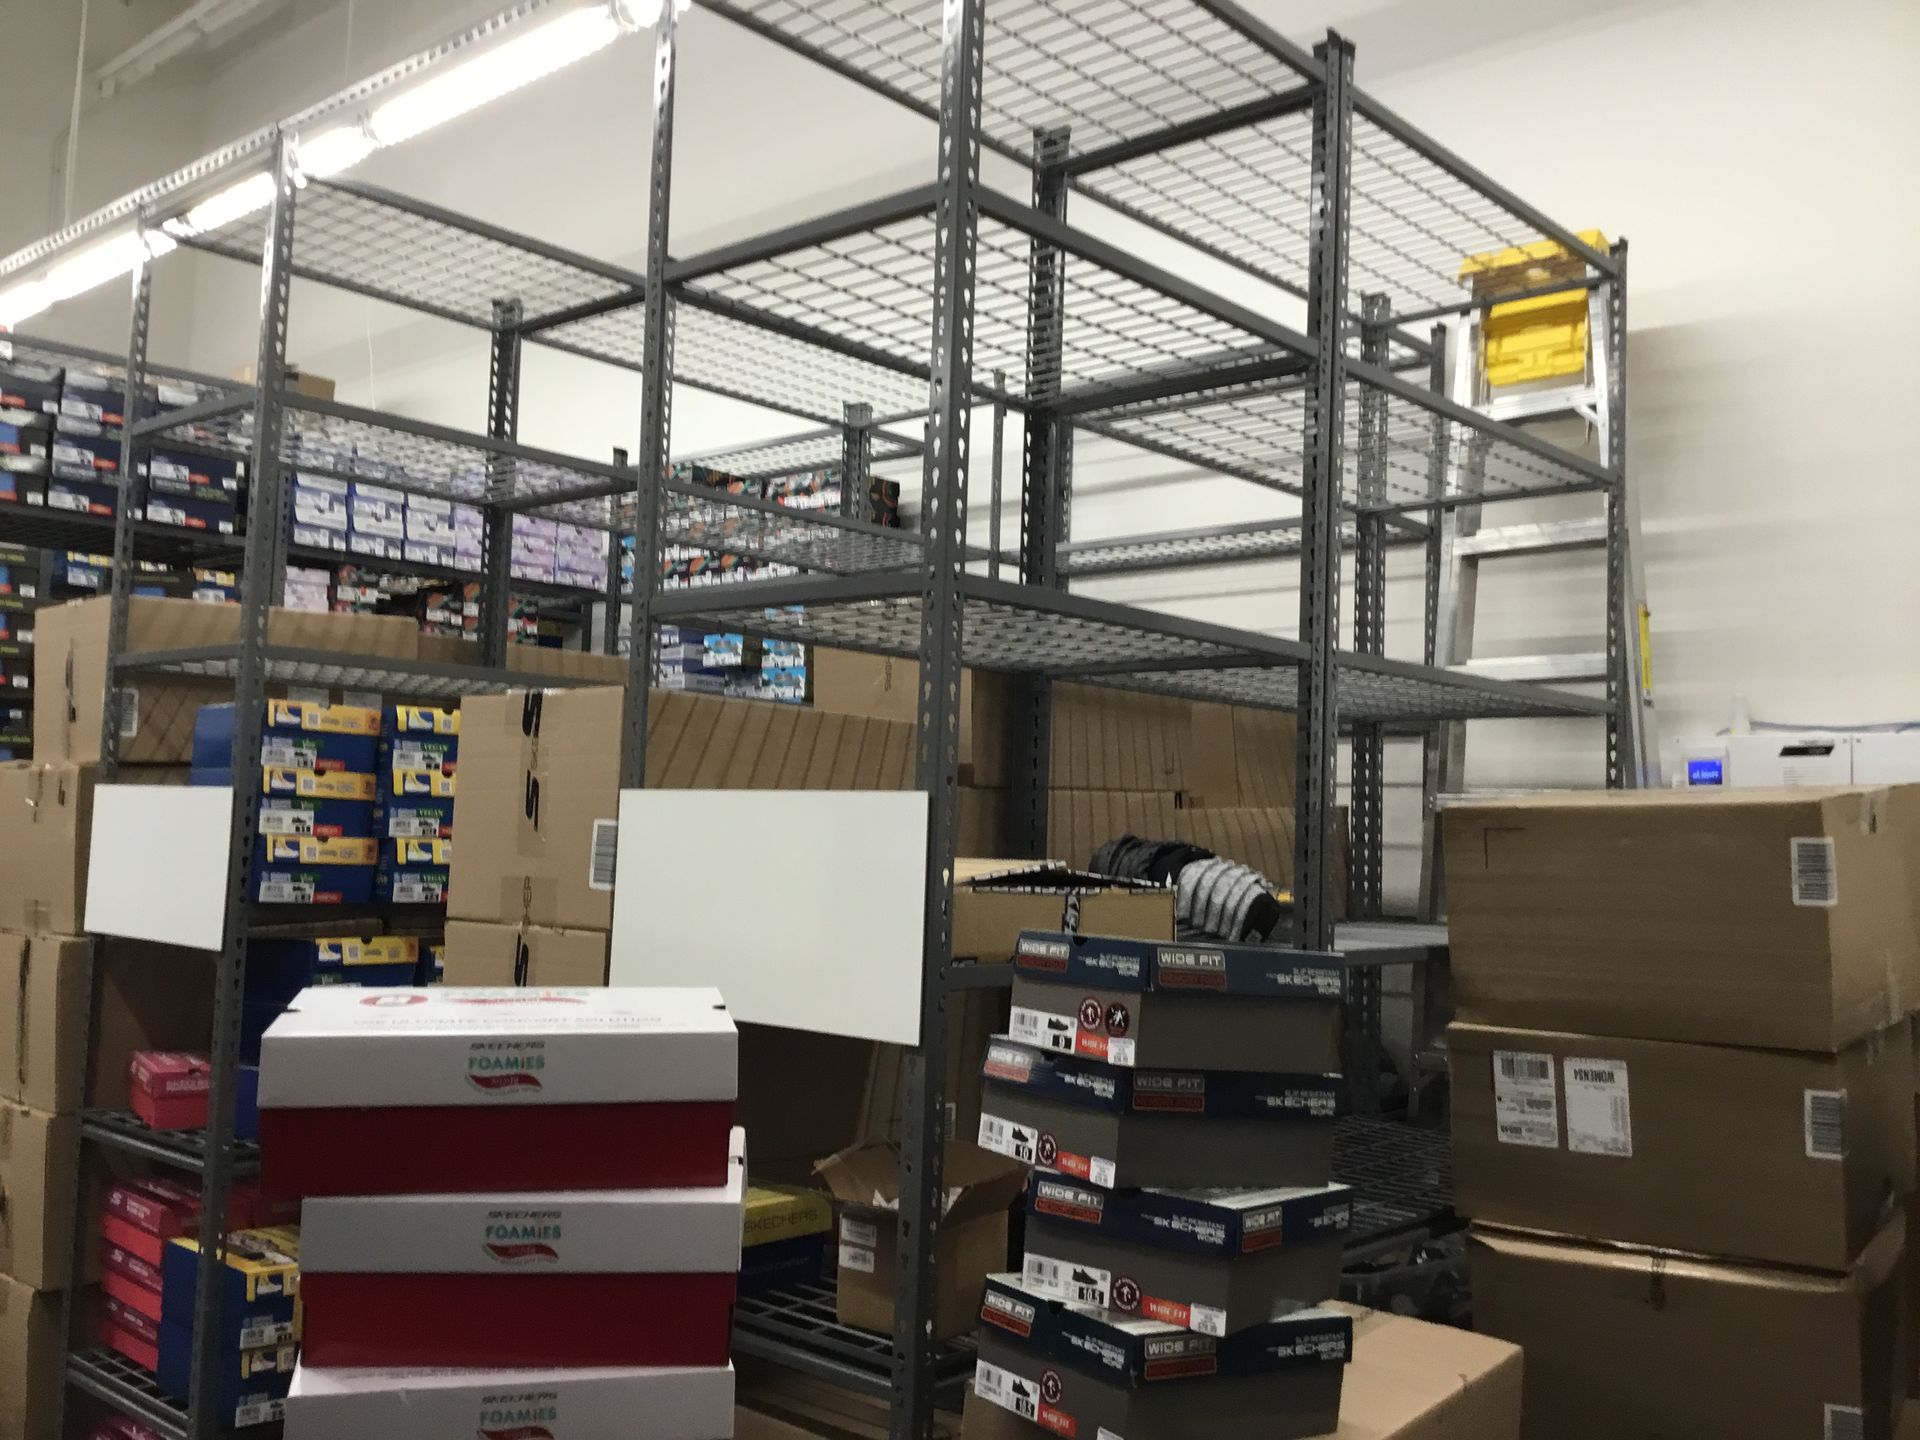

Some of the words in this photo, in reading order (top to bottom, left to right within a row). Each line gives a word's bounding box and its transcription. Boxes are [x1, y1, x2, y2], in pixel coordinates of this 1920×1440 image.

[419, 809, 443, 818] VEGAN
[423, 873, 448, 882] VEGAN
[1021, 943, 1047, 955] WIDE
[1050, 946, 1065, 957] FIT
[1085, 957, 1140, 972] SKECHERS
[1160, 952, 1196, 966] WIDE
[1200, 955, 1222, 967] FIT
[1277, 973, 1340, 987] SKECHERS
[470, 1041, 545, 1051] SKECHERS
[1136, 1076, 1173, 1089] WIDE
[1178, 1078, 1201, 1090] FIT
[1267, 1096, 1336, 1109] SKECHERS
[1041, 1185, 1074, 1200] WIDE
[1077, 1194, 1099, 1206] FIT
[487, 1210, 562, 1219] SKECHERS
[1153, 1217, 1226, 1239] SKECHERS
[1083, 1286, 1101, 1302] 10.5
[987, 1294, 1012, 1312] WIDE
[1014, 1304, 1033, 1317] FIT
[1150, 1302, 1171, 1315] WIDE
[1071, 1337, 1125, 1364] SKECHERS
[1147, 1340, 1185, 1354] WIDE
[1189, 1339, 1212, 1351] FIT
[1278, 1340, 1346, 1358] SKECHERS
[481, 1391, 558, 1404] SKECHERS
